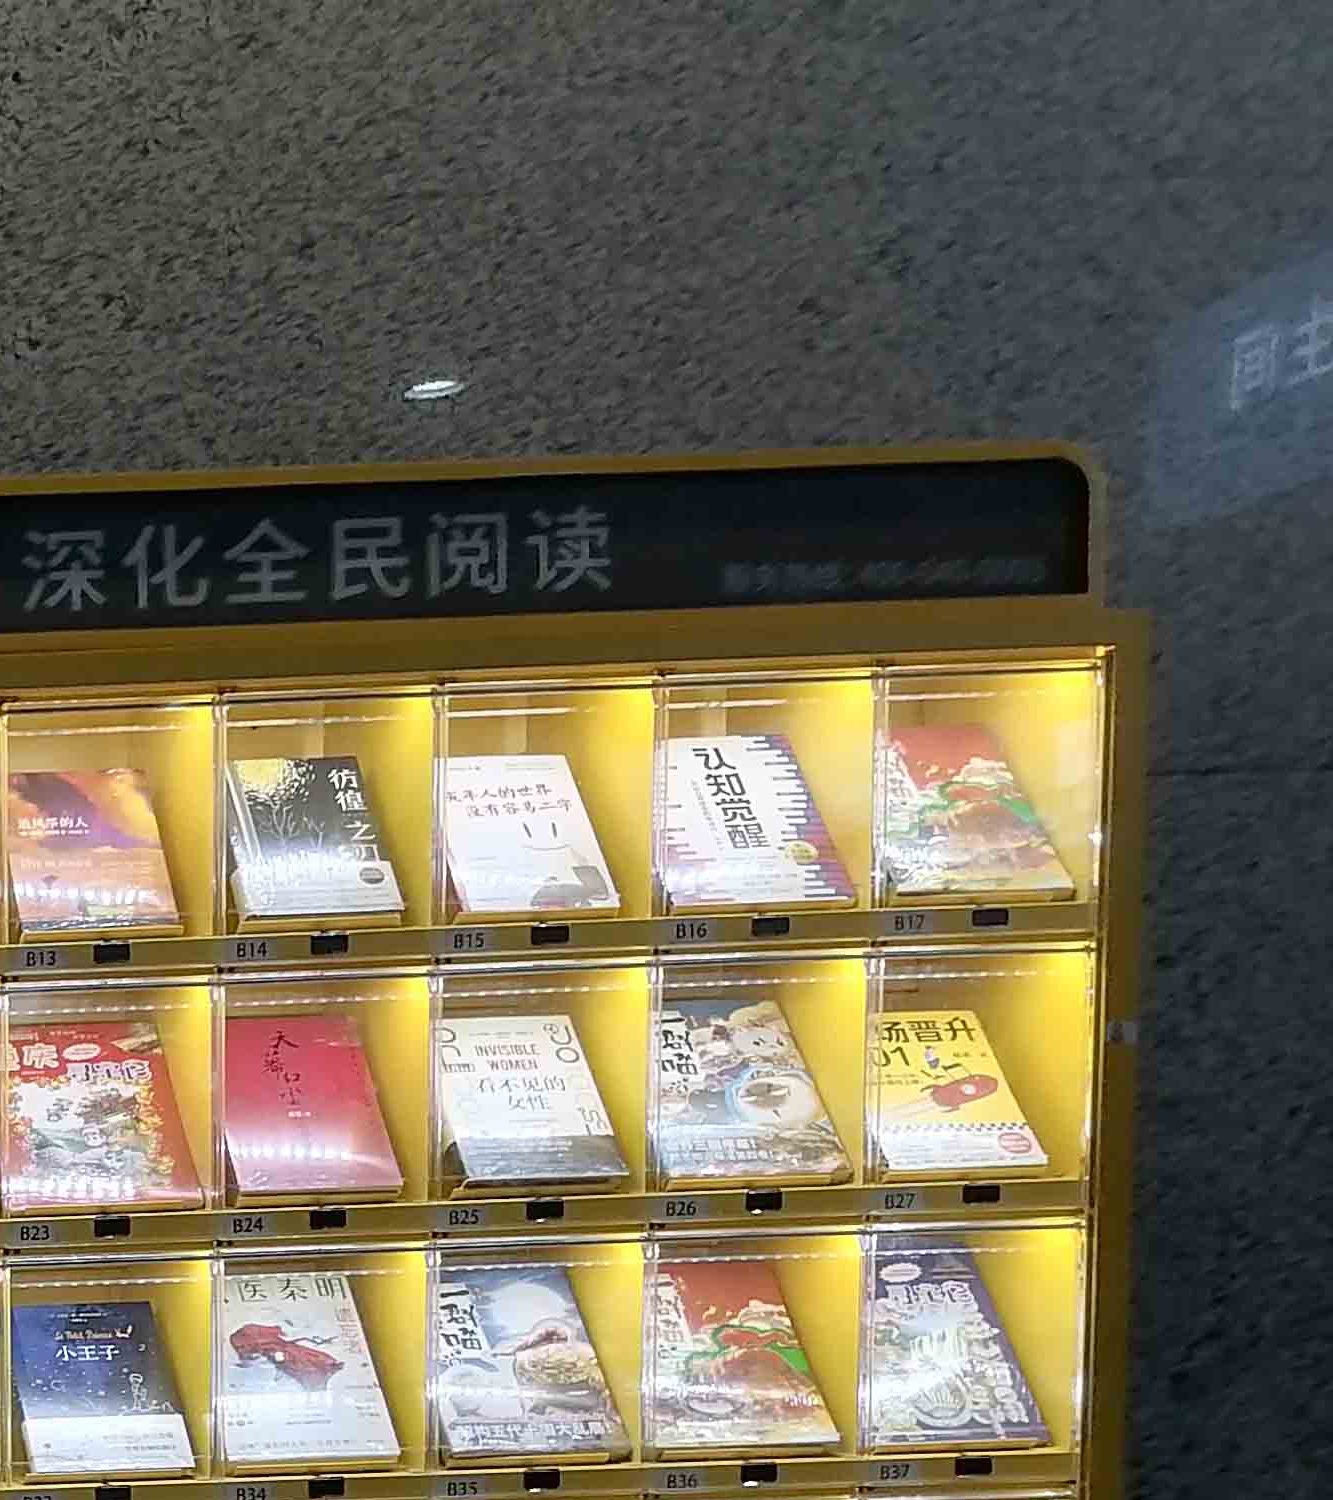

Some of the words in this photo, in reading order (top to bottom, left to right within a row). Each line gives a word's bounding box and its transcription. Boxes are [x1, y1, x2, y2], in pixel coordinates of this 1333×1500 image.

[23, 506, 613, 612] 深化全民阅读
[692, 746, 771, 850] 认知觉醒
[675, 923, 709, 940] B16
[894, 914, 926, 932] B17
[236, 942, 268, 957] B14
[453, 933, 485, 950] B15
[25, 951, 57, 968] B13
[474, 1042, 542, 1058] INVISIBLE
[489, 1058, 540, 1071] WOMEN
[448, 1209, 480, 1226] B25
[665, 1201, 697, 1218] B26
[232, 1216, 265, 1233] B24
[19, 1226, 51, 1242] B23
[55, 1344, 121, 1362] 小王子
[446, 1481, 478, 1498] B35
[666, 1474, 698, 1490] B36
